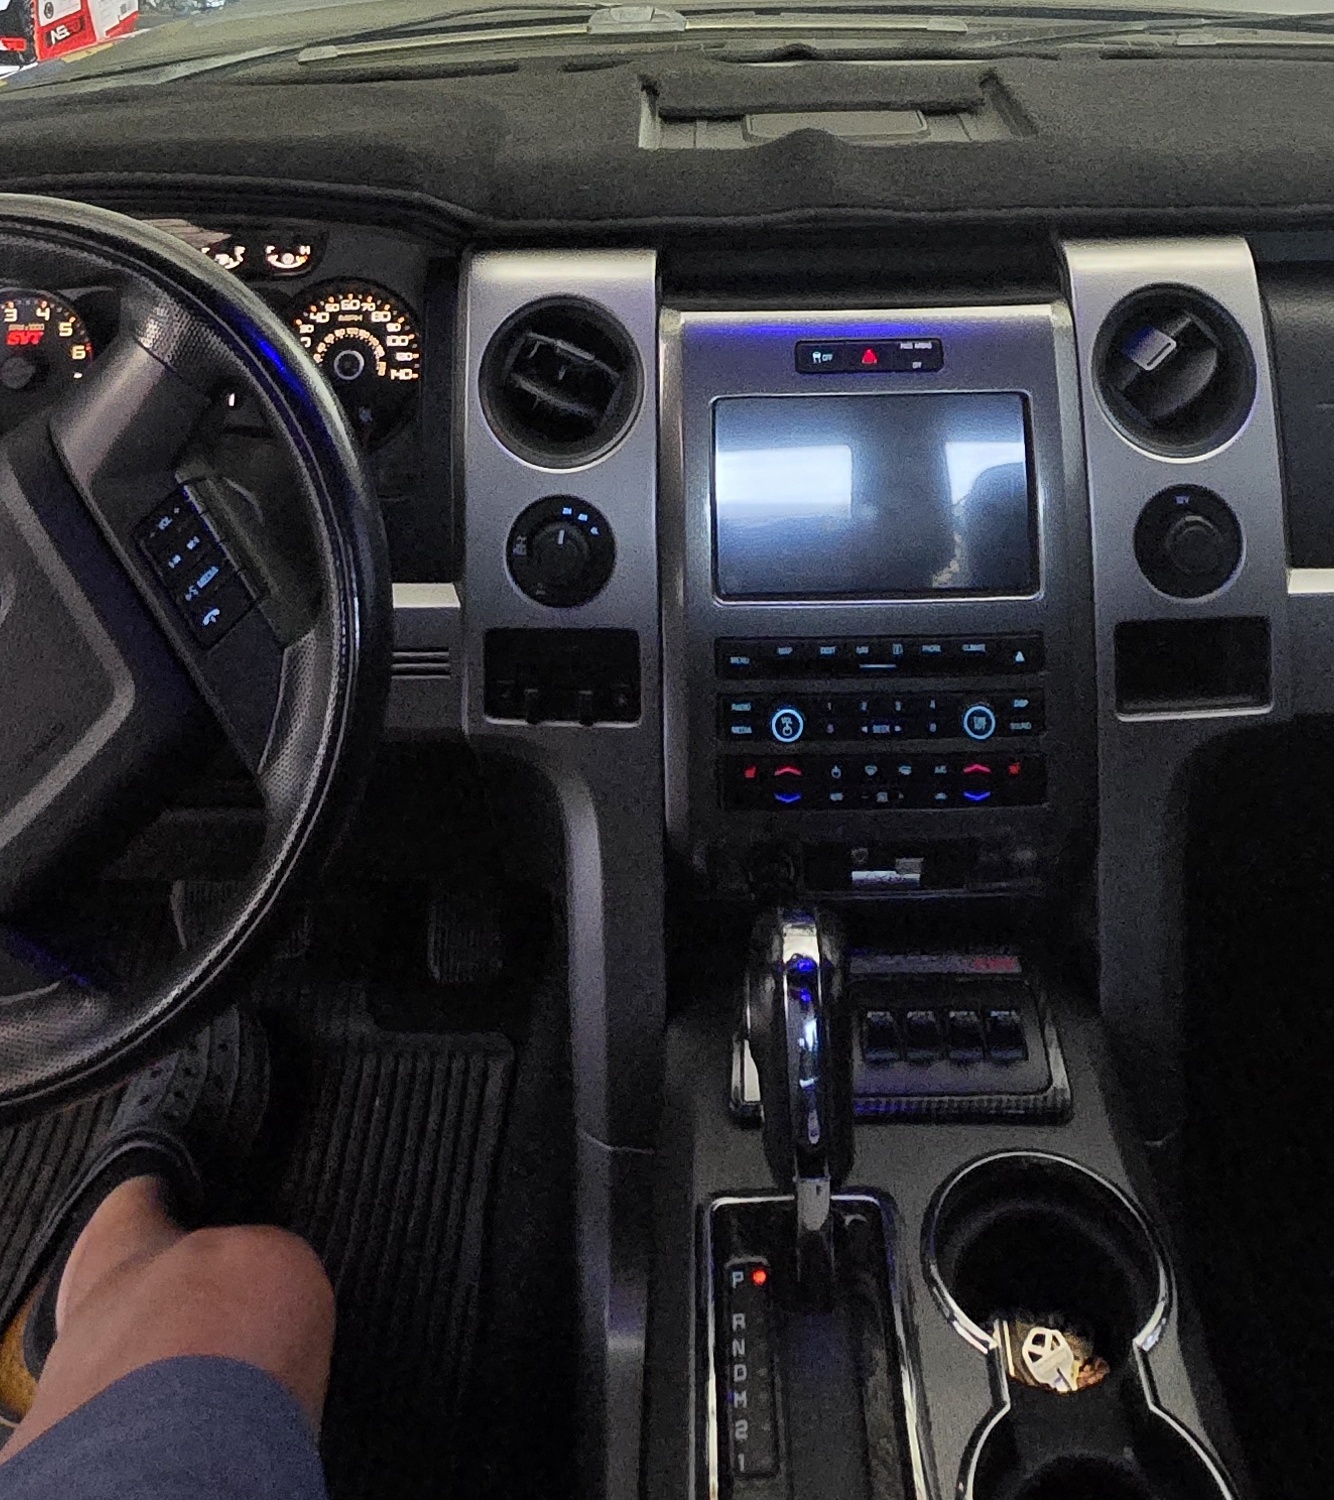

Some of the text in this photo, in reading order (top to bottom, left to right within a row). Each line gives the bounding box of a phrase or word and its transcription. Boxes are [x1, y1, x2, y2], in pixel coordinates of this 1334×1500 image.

[4, 307, 18, 323] 3
[36, 306, 51, 321] 4
[6, 330, 44, 346] SVT
[58, 322, 73, 337] 5
[71, 344, 86, 360] 6
[732, 1271, 744, 1289] P
[732, 1313, 746, 1332] R
[732, 1338, 746, 1357] N
[733, 1364, 748, 1383] D
[733, 1390, 747, 1409] M
[734, 1419, 748, 1440] 2
[737, 1453, 745, 1472] 1
